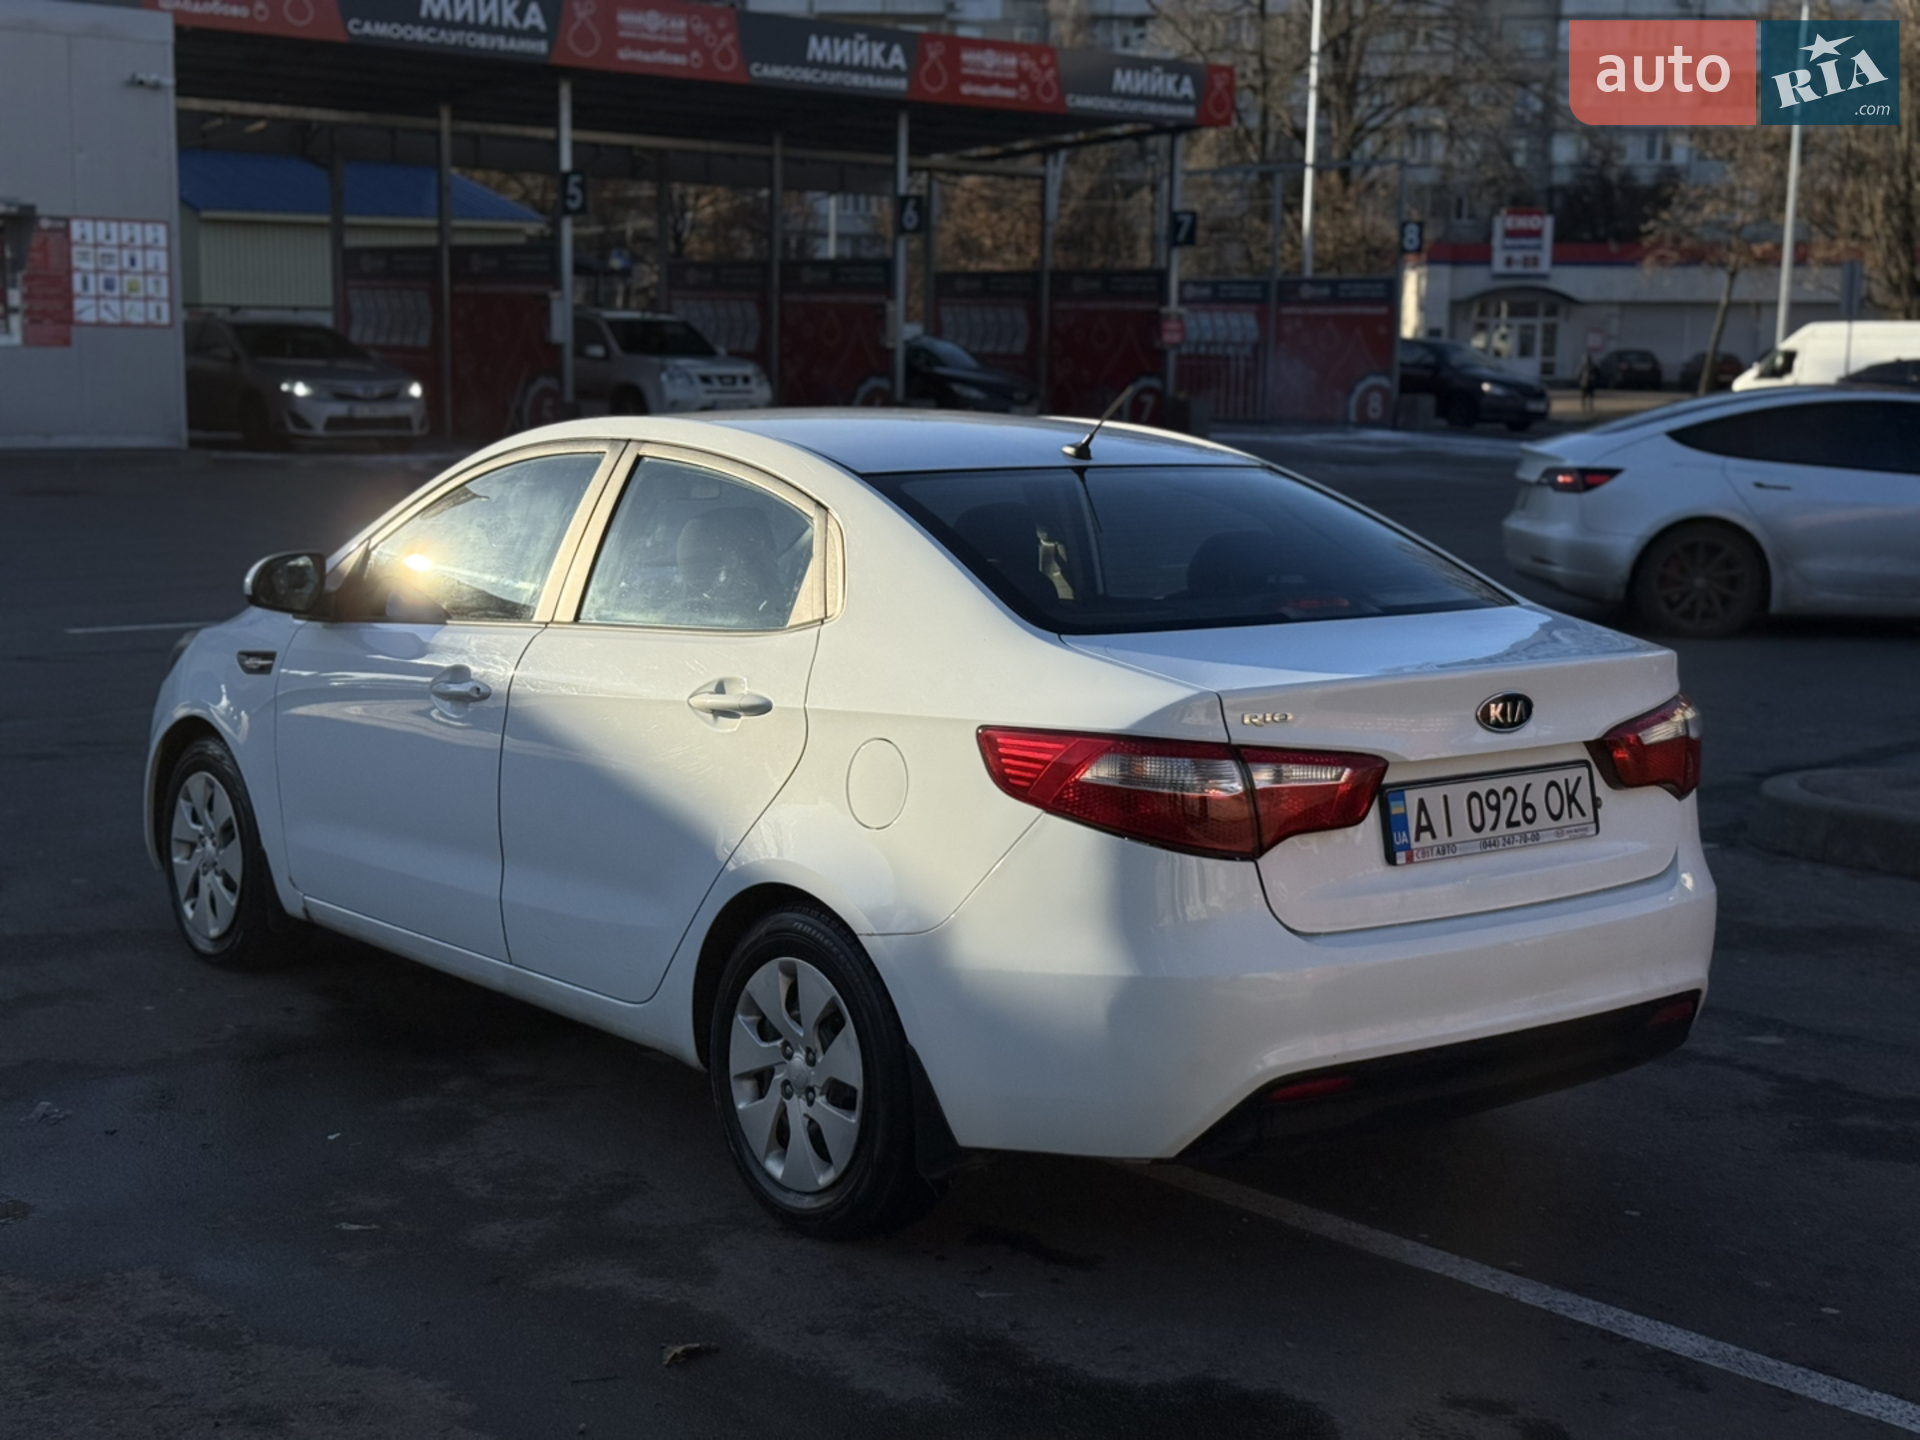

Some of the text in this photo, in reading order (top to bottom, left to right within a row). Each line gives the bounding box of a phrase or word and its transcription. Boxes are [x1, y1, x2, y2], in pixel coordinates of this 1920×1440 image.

[806, 32, 908, 72] МИЙКА
[1111, 65, 1197, 101] МИЙКА
[565, 174, 583, 210] 5
[902, 199, 919, 230] 6
[1176, 214, 1193, 243] 7
[1402, 223, 1420, 251] 8
[1139, 393, 1155, 423] 7
[1366, 391, 1383, 420] 8
[1241, 712, 1294, 727] RIO
[1488, 700, 1527, 724] KIA
[1414, 776, 1587, 842] AI 0926 OK
[1393, 831, 1409, 845] UA
[1479, 832, 1541, 851] (044) 247-70-00
